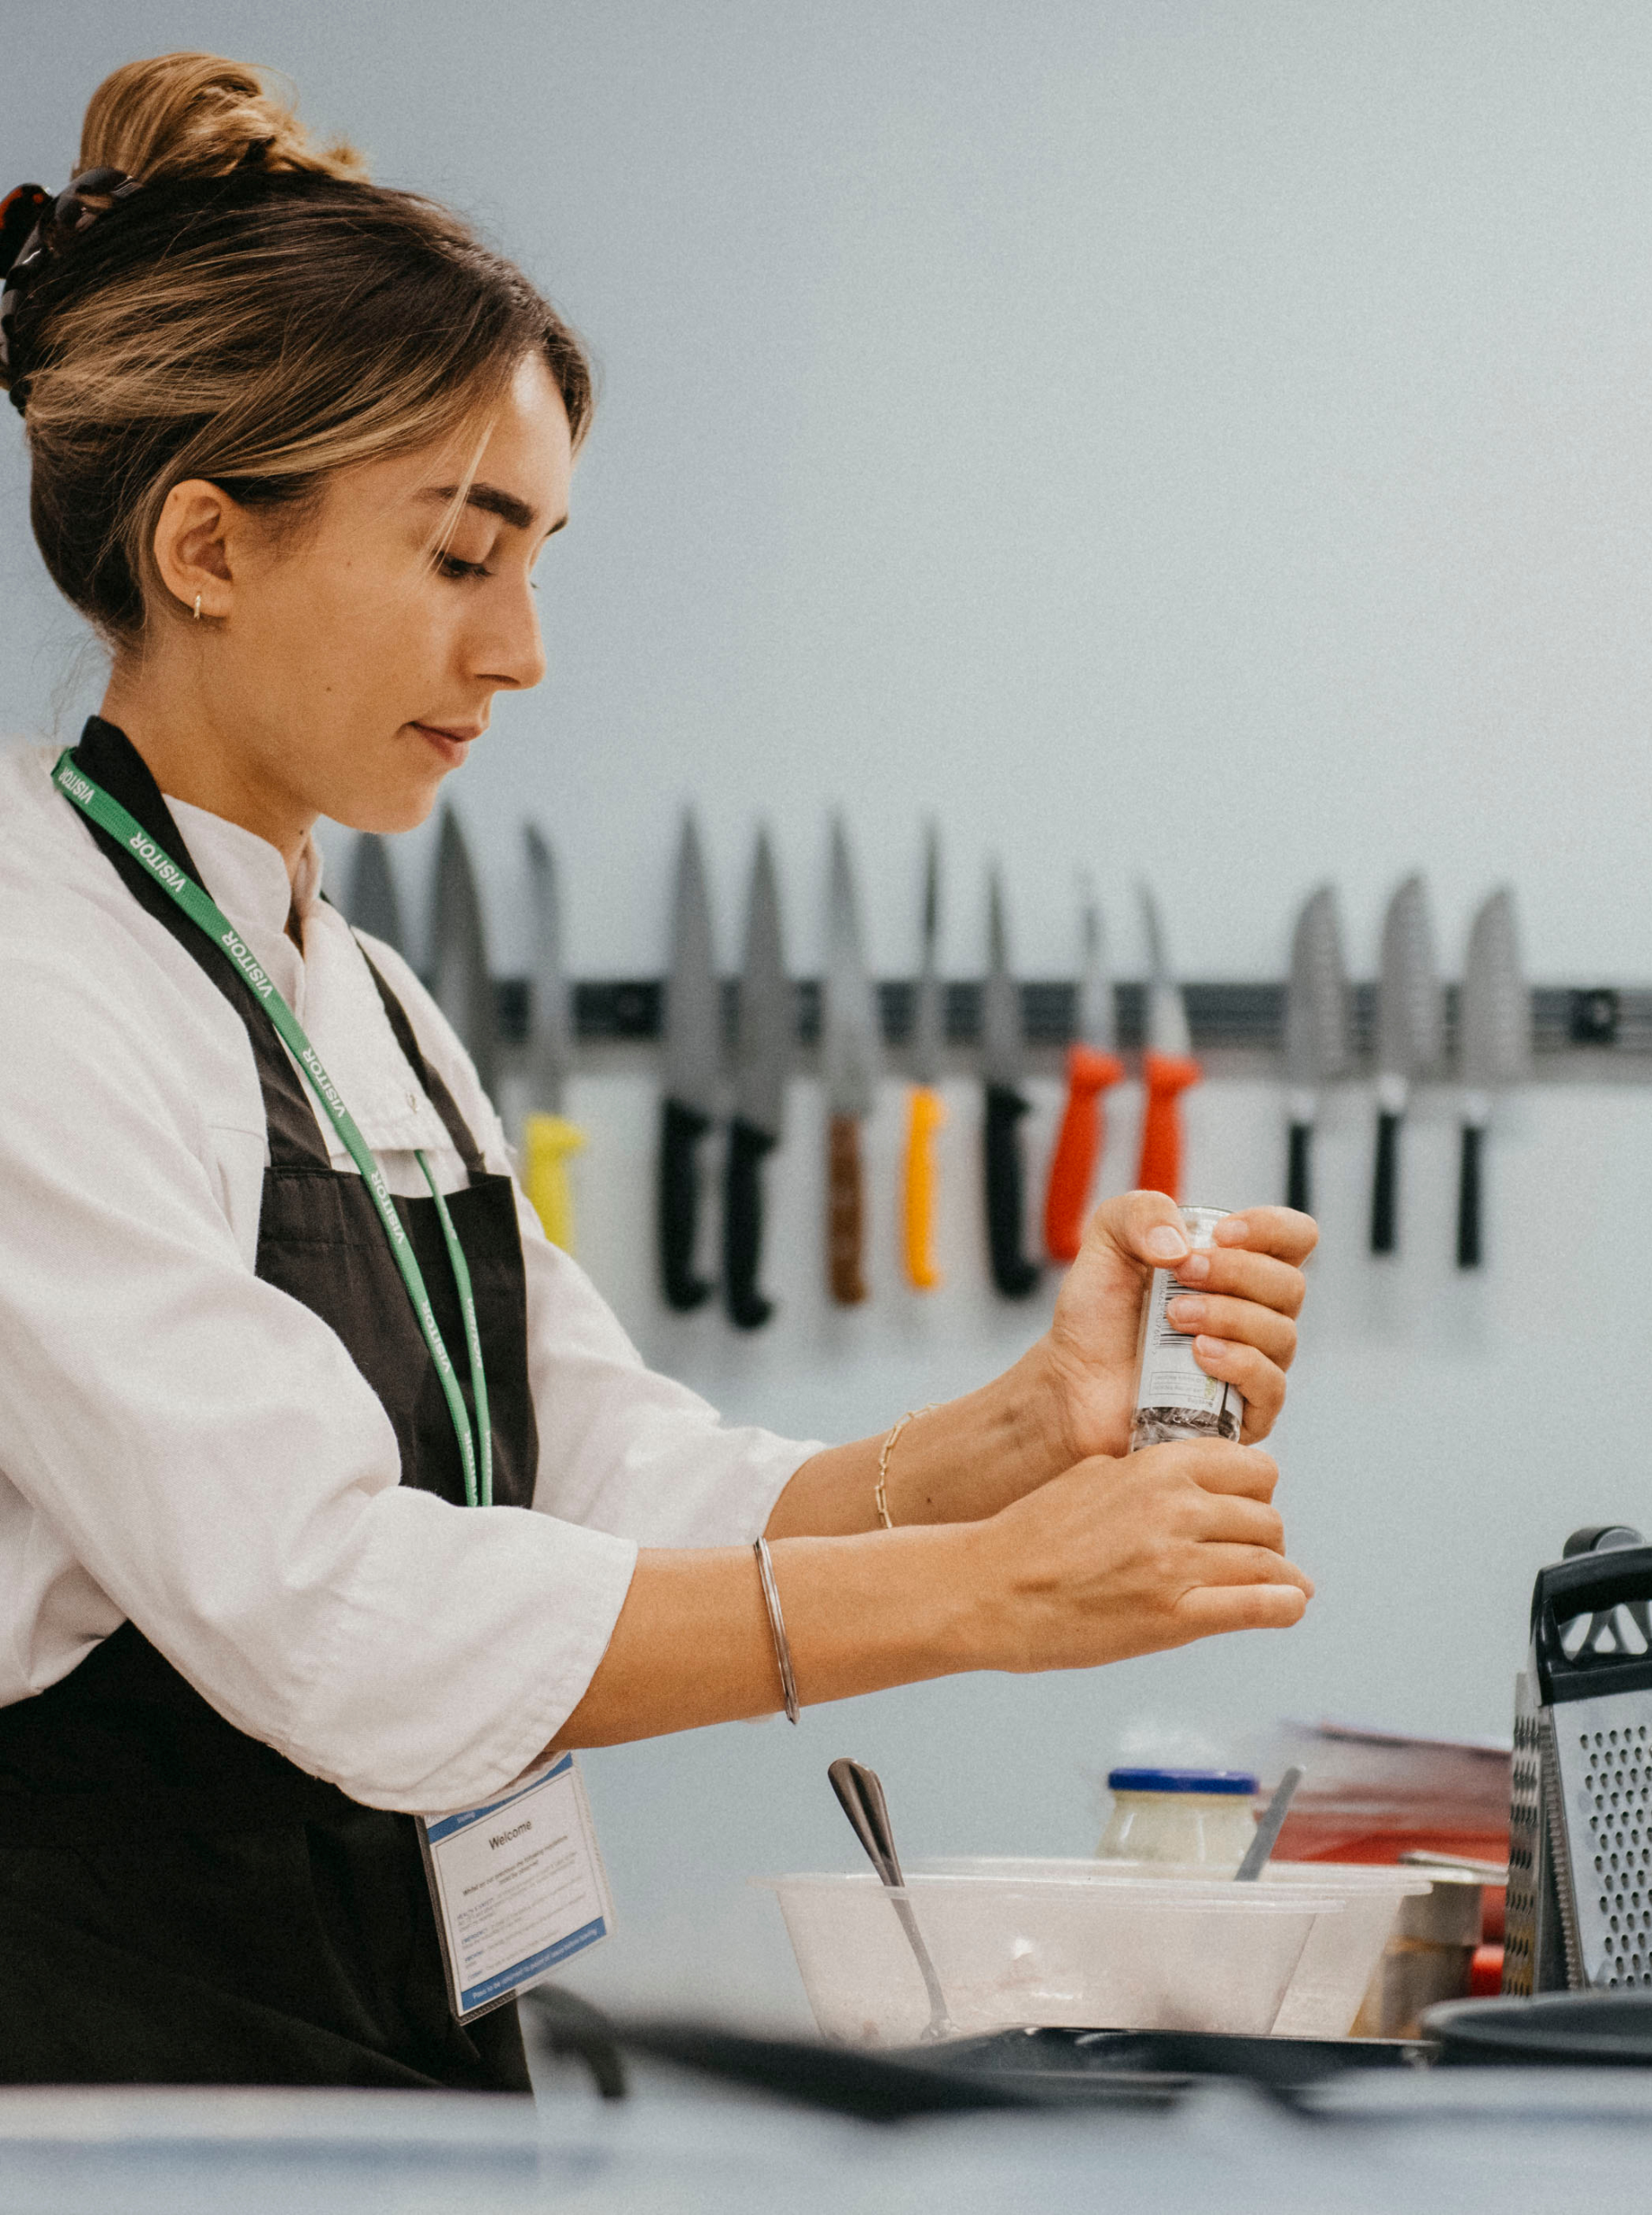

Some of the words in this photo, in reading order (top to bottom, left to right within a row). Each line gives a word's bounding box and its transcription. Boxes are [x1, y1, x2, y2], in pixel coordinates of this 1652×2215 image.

[58, 767, 95, 805] VISITOR
[129, 832, 186, 892] VISITOR
[221, 931, 274, 998] VISITOR
[303, 1048, 348, 1118] VISITOR
[371, 1173, 406, 1245] VISITOR
[422, 1301, 452, 1374] VISITOR
[488, 1819, 533, 1852] Welcome
